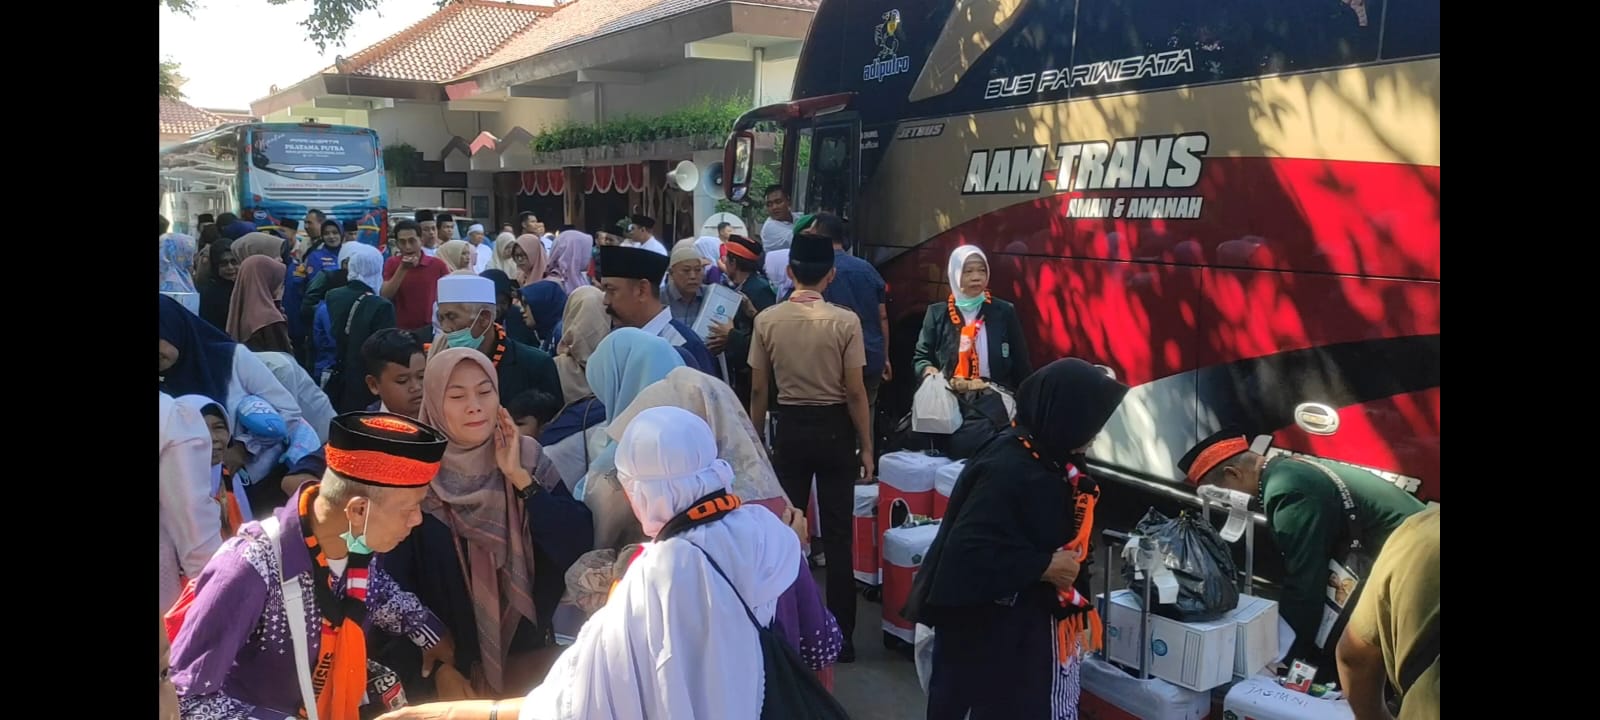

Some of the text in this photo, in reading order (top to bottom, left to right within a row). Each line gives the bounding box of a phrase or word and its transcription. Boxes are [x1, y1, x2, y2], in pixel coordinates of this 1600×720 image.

[863, 54, 909, 82] adiputro
[984, 48, 1193, 99] BUS PARIWISATA
[961, 132, 1209, 195] AAM TRANS
[1066, 196, 1203, 219] AMAN & AMANAH
